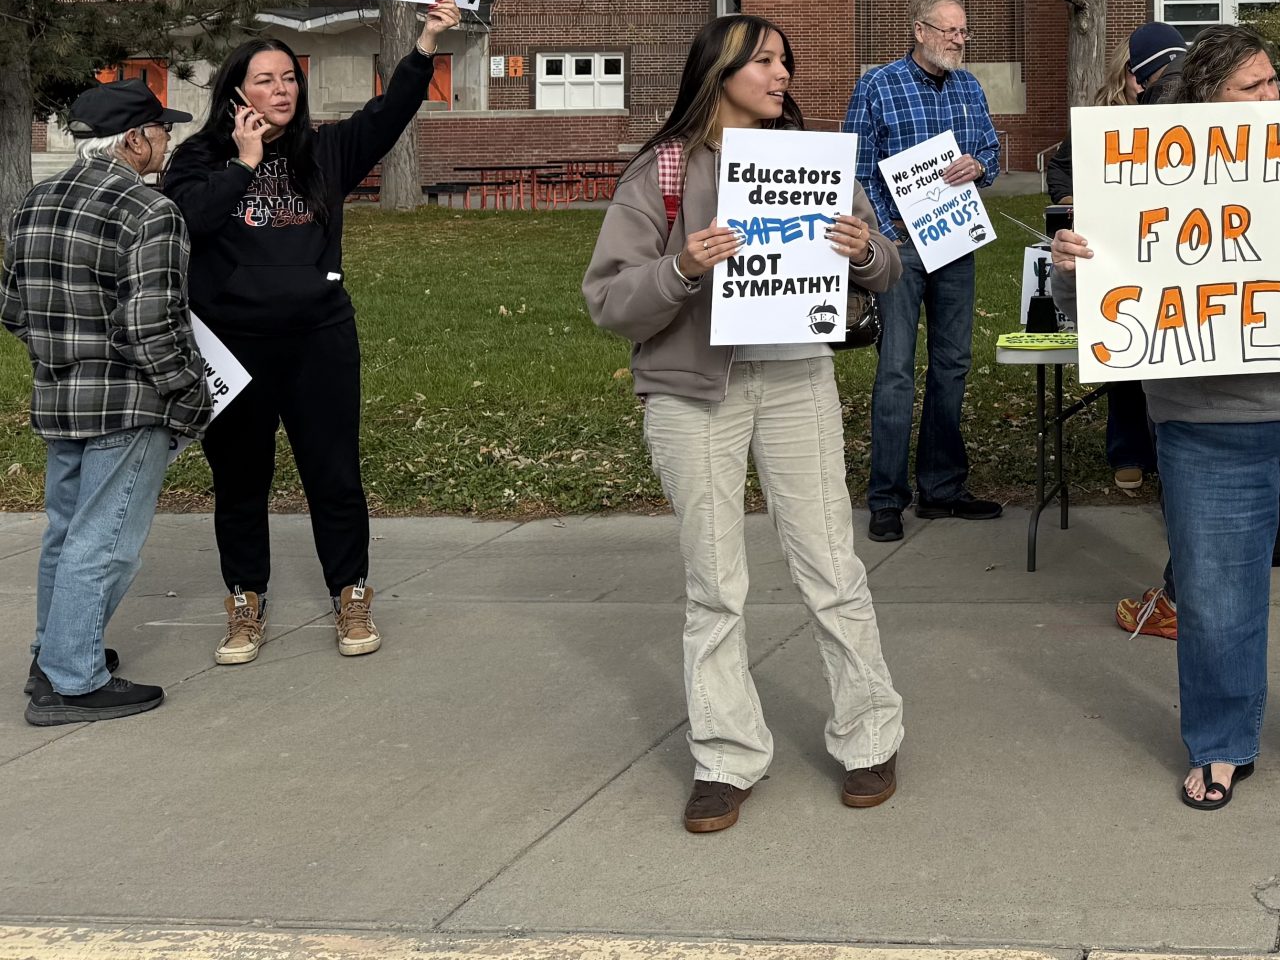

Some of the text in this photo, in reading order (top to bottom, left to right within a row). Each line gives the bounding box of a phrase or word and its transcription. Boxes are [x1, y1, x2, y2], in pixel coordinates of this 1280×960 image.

[727, 162, 842, 186] Educators
[891, 149, 955, 185] We show up
[895, 167, 947, 198] for stude
[748, 185, 838, 207] deserve
[911, 189, 973, 230] WHO SHOWS UP
[918, 200, 981, 246] FOR US?
[1137, 204, 1263, 266] FOR
[726, 253, 782, 278] NOT
[722, 275, 841, 299] SYMPATHY!
[810, 313, 836, 323] BEA
[213, 377, 230, 396] up
